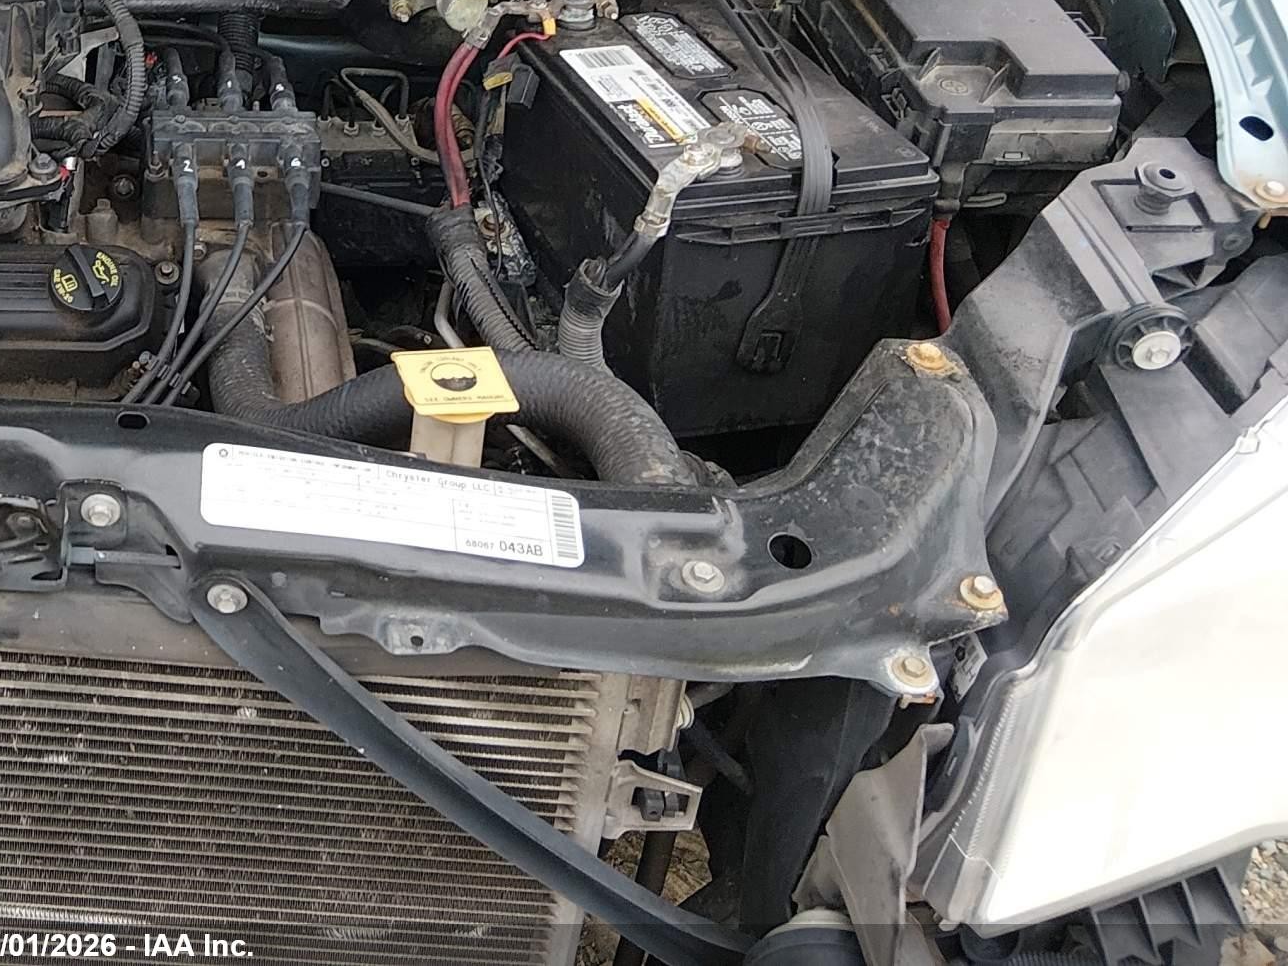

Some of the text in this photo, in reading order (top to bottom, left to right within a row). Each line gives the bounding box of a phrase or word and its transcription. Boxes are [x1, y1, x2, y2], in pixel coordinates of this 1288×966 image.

[616, 104, 666, 144] Duralast
[183, 159, 193, 172] 2
[96, 251, 119, 287] ENGINE OIL
[385, 470, 431, 483] Chrysler
[438, 477, 467, 491] Group
[472, 482, 490, 492] LLC
